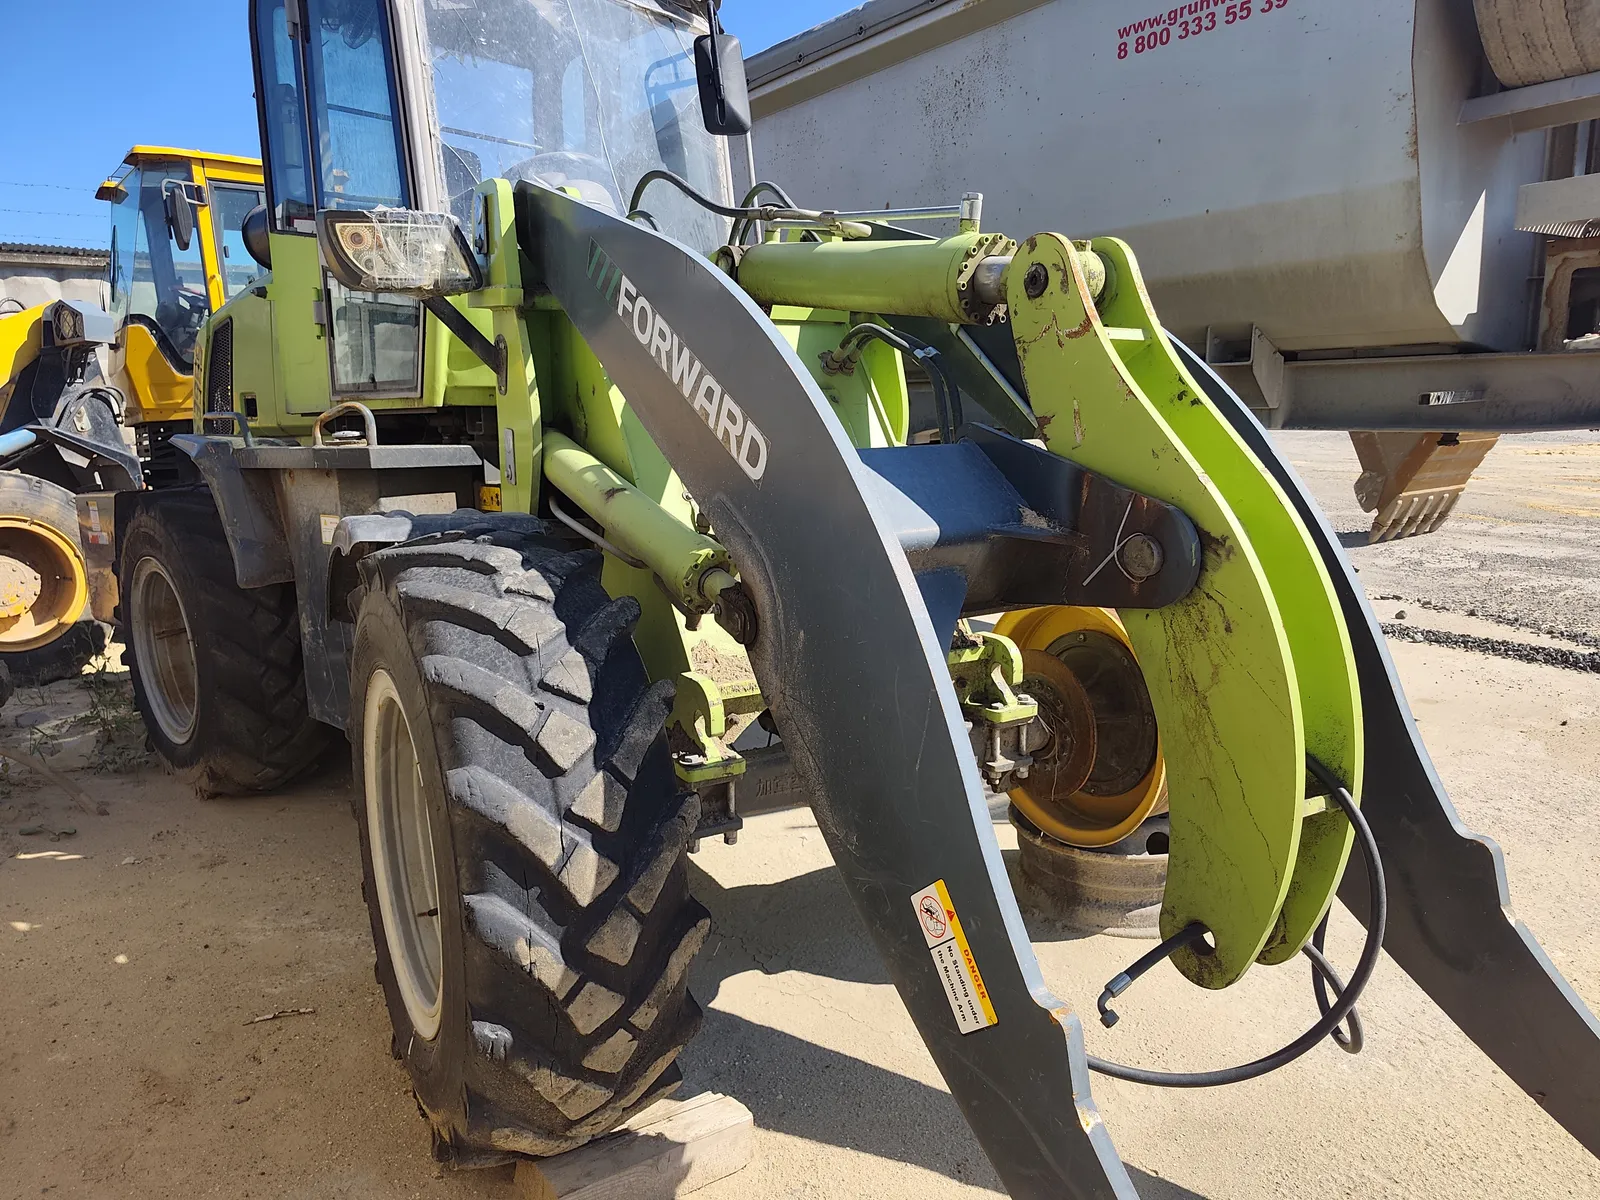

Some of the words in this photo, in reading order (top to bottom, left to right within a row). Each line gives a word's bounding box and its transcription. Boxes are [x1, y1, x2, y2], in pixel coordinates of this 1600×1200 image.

[1116, 41, 1129, 60] 8
[1134, 27, 1171, 54] 800
[1177, 11, 1217, 40] 333
[1224, 0, 1252, 25] 55
[617, 275, 768, 481] FORWARD
[937, 950, 945, 964] the
[943, 965, 959, 1002] Machine
[957, 1003, 967, 1022] Arm
[946, 945, 954, 958] No
[952, 959, 969, 998] Standing
[967, 999, 980, 1024] under
[963, 949, 986, 1000] DANGER
